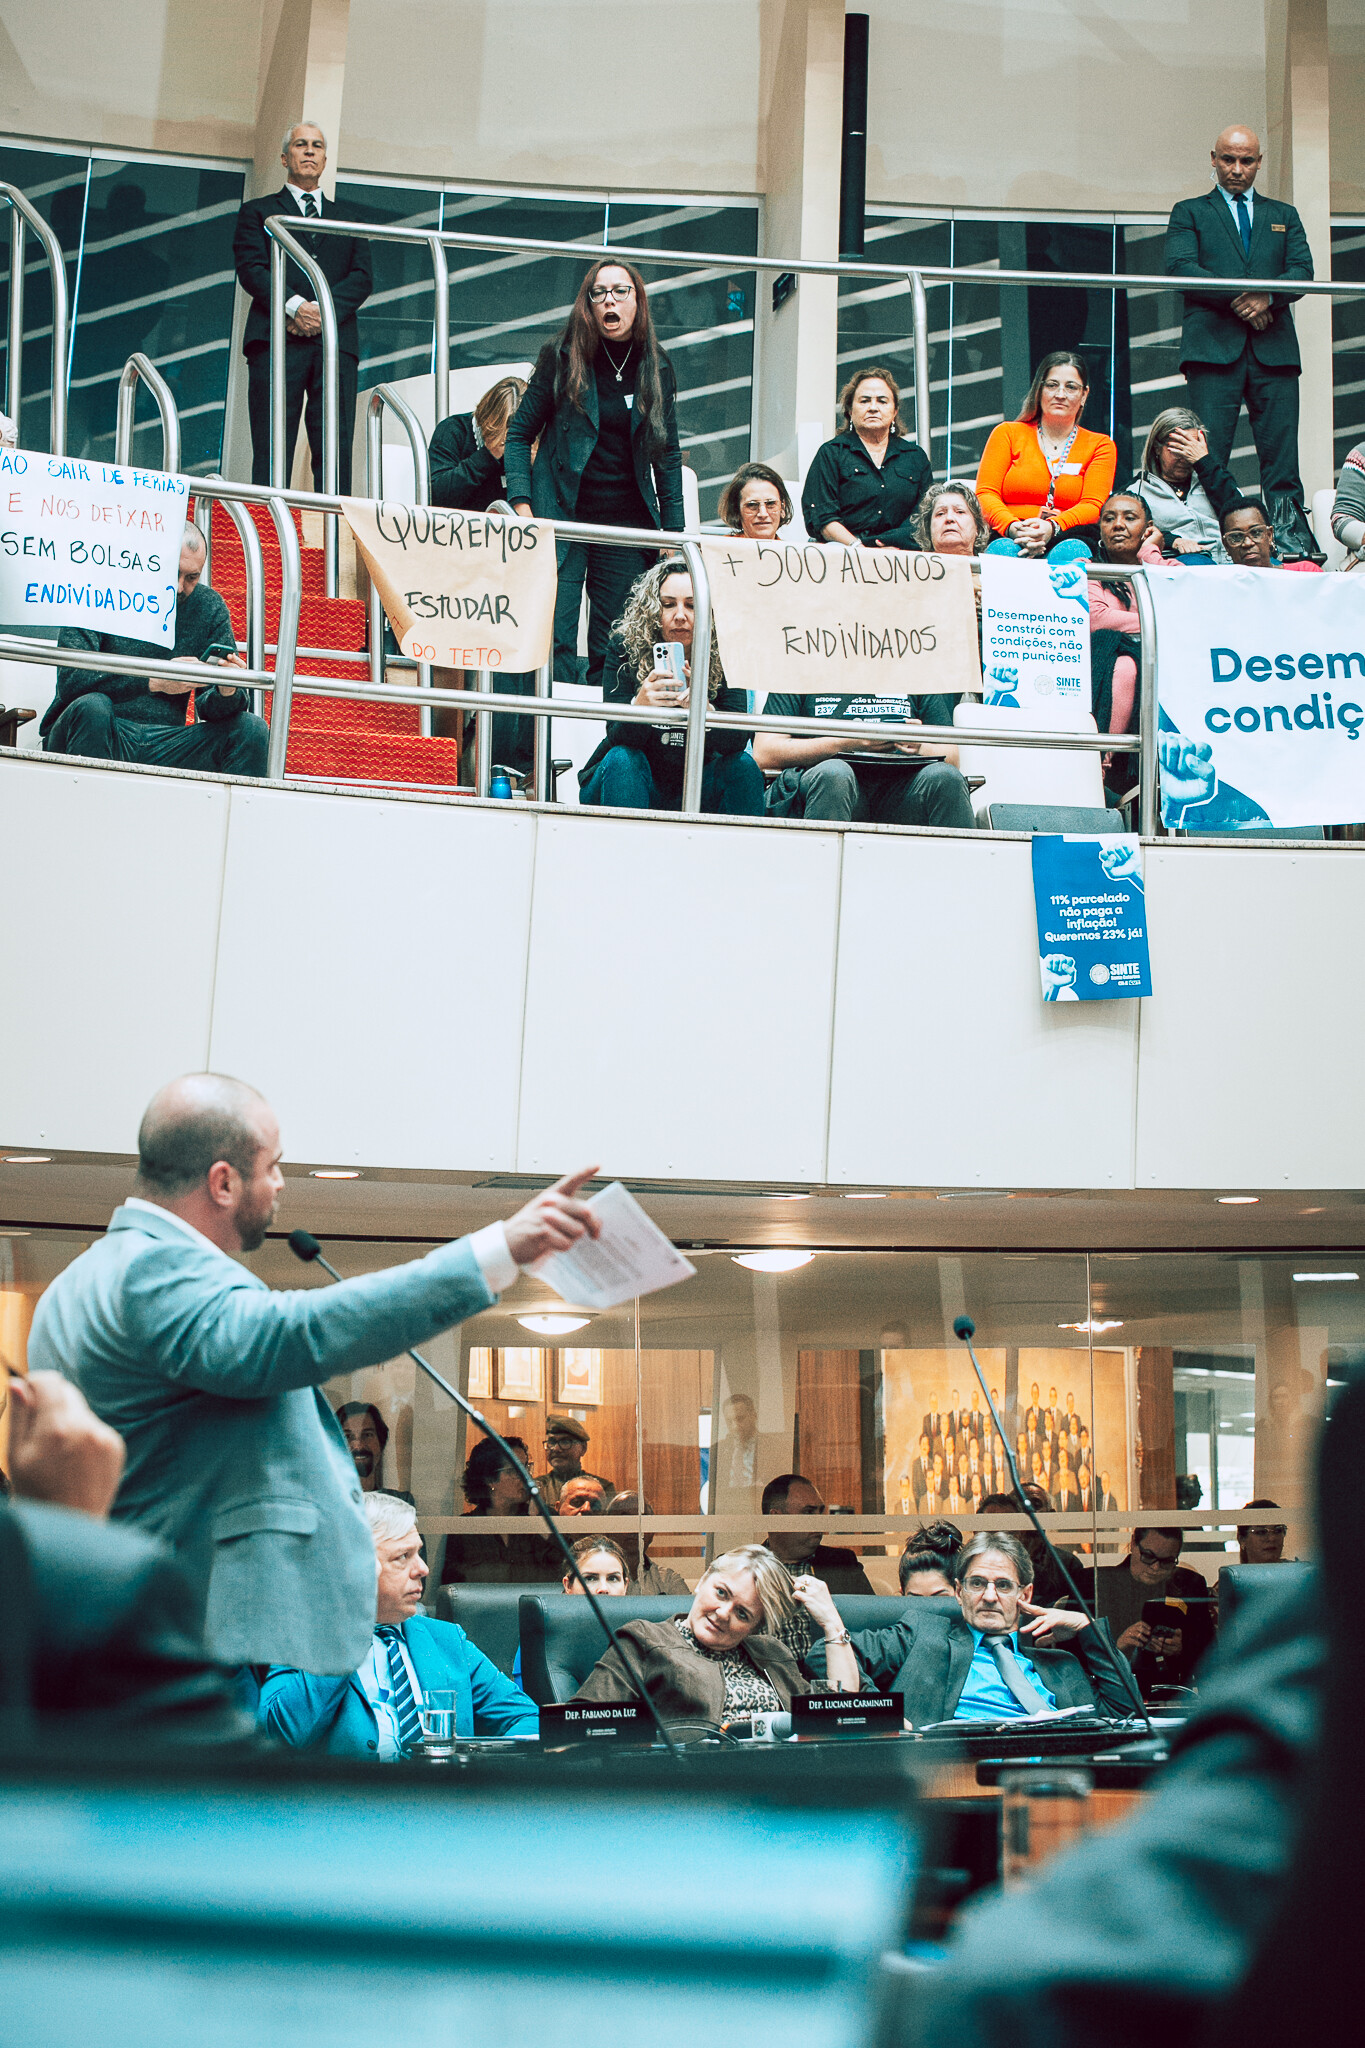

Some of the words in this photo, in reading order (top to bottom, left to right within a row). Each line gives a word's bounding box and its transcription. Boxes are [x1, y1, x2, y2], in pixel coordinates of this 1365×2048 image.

[102, 468, 124, 485] DE
[9, 492, 23, 512] E
[41, 495, 80, 519] NOS
[376, 501, 539, 563] QUEREMOS
[1, 531, 56, 561] SEM
[70, 540, 161, 572] BOLSAS
[722, 553, 743, 576] +
[756, 541, 827, 586] 500
[841, 548, 946, 584] ALUNOS
[404, 591, 519, 628] ESTUDAR
[988, 608, 1068, 625] Desempenho
[1071, 616, 1084, 625] se
[997, 624, 1046, 635] constrói
[1048, 629, 1076, 637] com
[990, 637, 1057, 650] condições,
[1059, 640, 1083, 651] não
[412, 643, 436, 660] DO
[449, 647, 502, 667] TETO
[992, 650, 1019, 659] com
[1022, 651, 1081, 664] punições!
[1056, 677, 1081, 688] SINTE
[851, 706, 896, 714] REAJUSTE
[1204, 691, 1364, 741] condiç
[1050, 894, 1071, 905] 11%
[1072, 893, 1130, 907] parcelado
[1059, 906, 1081, 917] não
[1083, 908, 1113, 918] paga
[1114, 907, 1123, 915] a
[1066, 917, 1117, 930] inflação!
[1044, 931, 1101, 943] Queremos
[1102, 928, 1126, 940] 23%
[1127, 928, 1143, 941] já!
[1109, 963, 1140, 975] SINTE
[623, 1707, 637, 1717] LUZ
